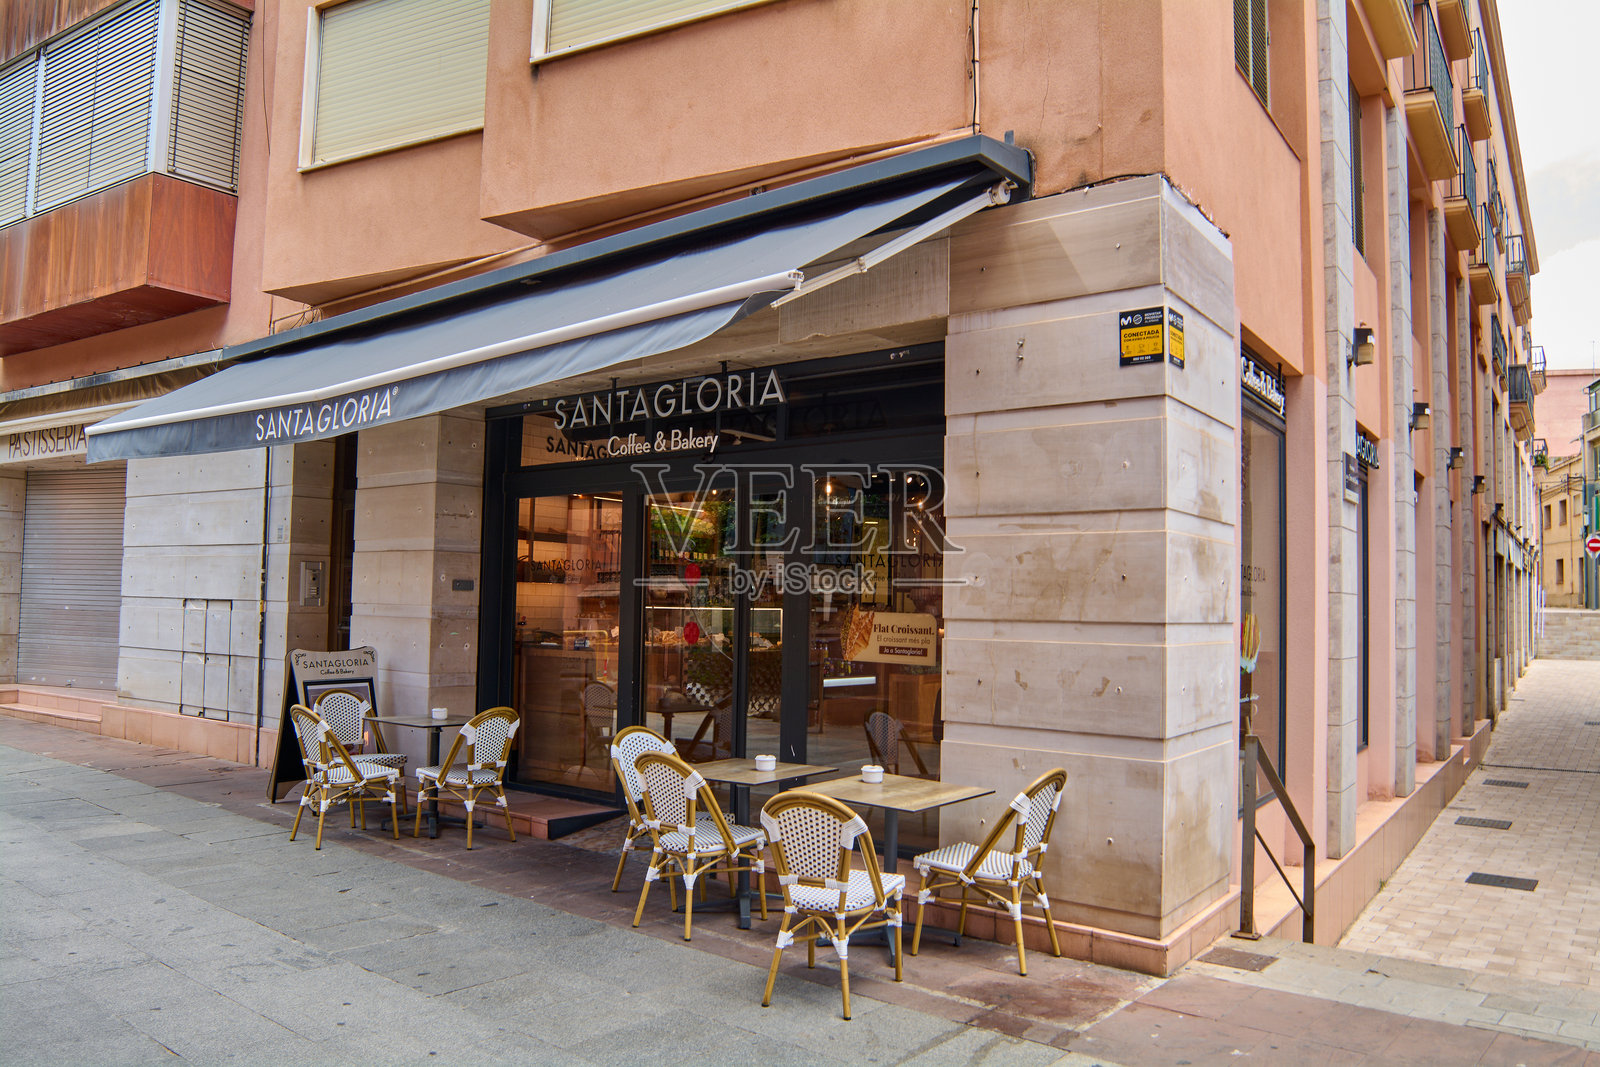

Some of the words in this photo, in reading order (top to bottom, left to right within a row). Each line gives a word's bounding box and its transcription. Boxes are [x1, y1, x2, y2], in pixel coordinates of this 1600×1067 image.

[1123, 329, 1160, 338] CONECTADA
[554, 368, 786, 430] SANTAGLORIA
[8, 423, 87, 459] PASTISSERIA
[607, 432, 651, 456] Coffee
[653, 430, 667, 453] &
[670, 427, 719, 453] Bakery
[530, 558, 602, 572] SANTAGLORIA
[873, 623, 889, 634] Flat
[890, 624, 935, 635] Croissant.
[876, 634, 883, 642] El
[883, 635, 908, 643] croissant
[920, 637, 931, 645] pla
[302, 658, 369, 669] SANTAGLORIA
